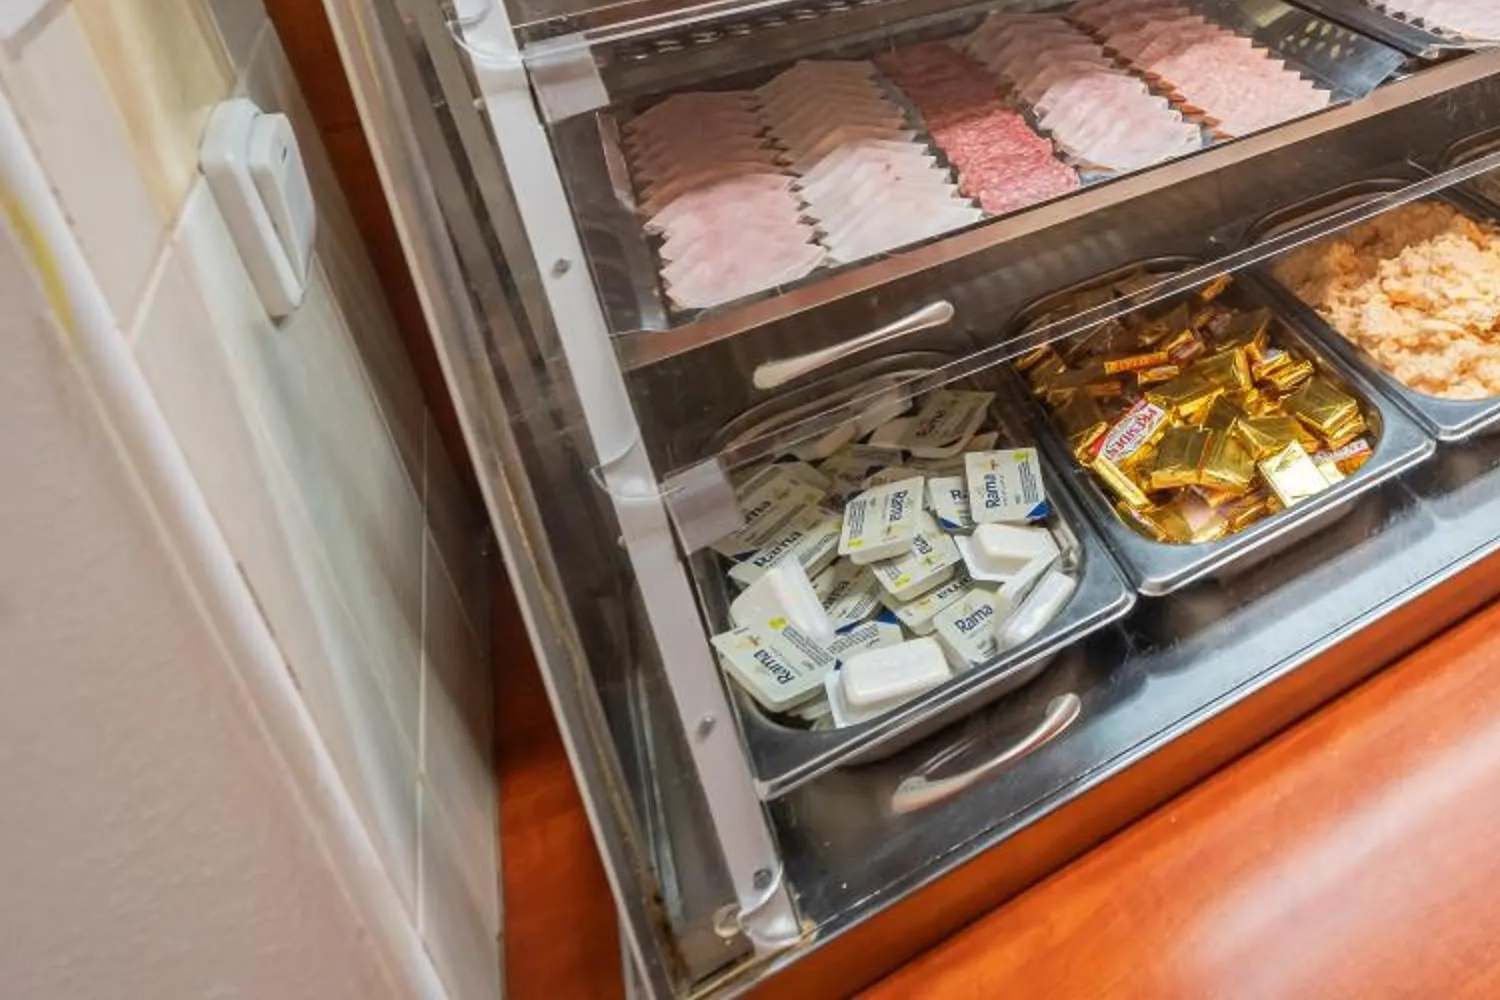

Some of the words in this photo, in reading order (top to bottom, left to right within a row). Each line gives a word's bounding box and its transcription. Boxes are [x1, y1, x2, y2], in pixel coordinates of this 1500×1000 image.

[983, 473, 1001, 509] Rama
[954, 603, 994, 633] Rama
[753, 648, 796, 685] Rama
